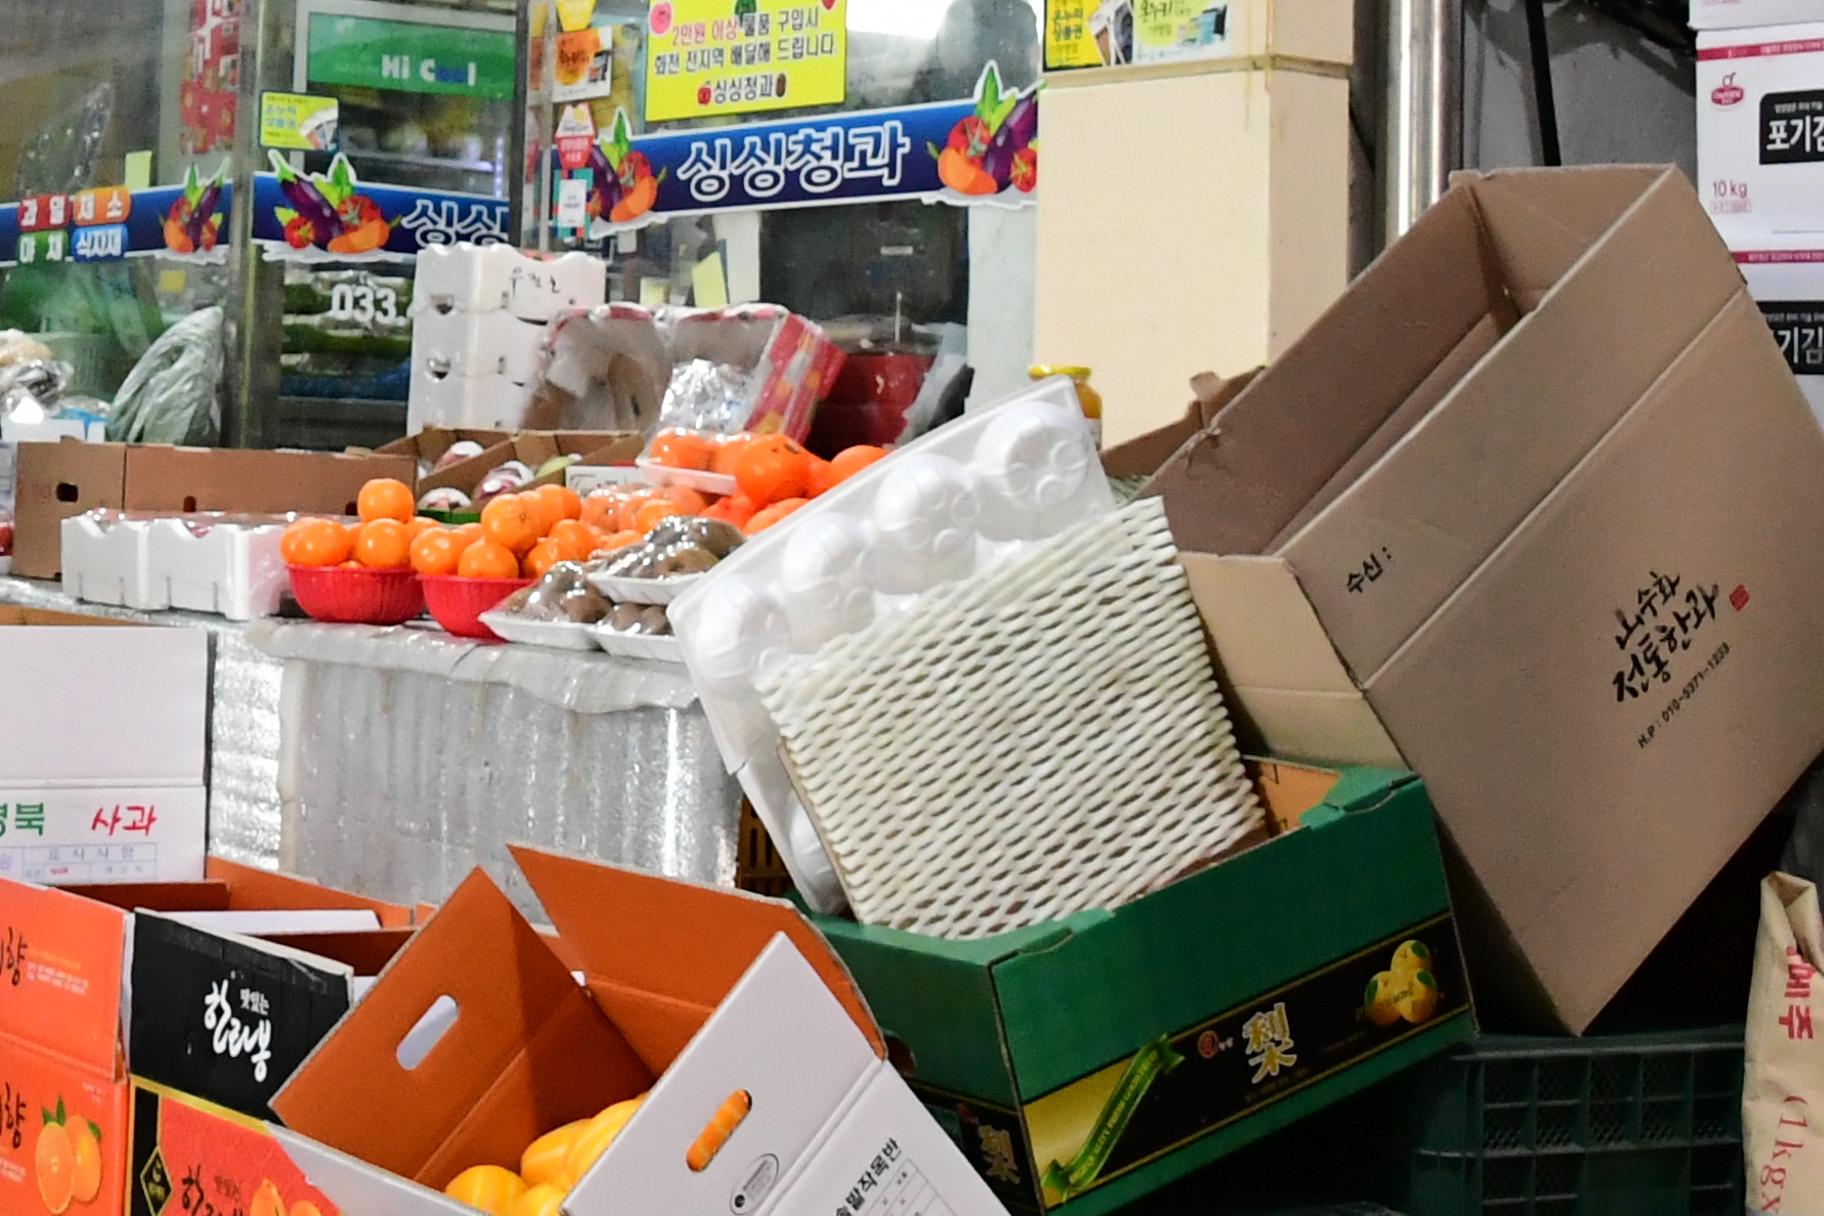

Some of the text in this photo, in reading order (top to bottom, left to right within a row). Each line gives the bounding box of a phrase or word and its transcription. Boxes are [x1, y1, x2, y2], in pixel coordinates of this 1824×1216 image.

[672, 21, 706, 47] 2만원
[711, 18, 739, 42] 이상
[777, 7, 819, 33] 구입시
[655, 53, 680, 76] 화천
[685, 47, 725, 73] 전지역
[730, 41, 771, 66] 배달해
[713, 74, 774, 105] 싱싱청과
[676, 120, 911, 204] 싱싱청과
[1712, 179, 1748, 198] 10 kg
[75, 228, 123, 258] 식자재
[1611, 582, 1720, 704] 전통한과
[90, 803, 158, 837] 사과
[239, 988, 271, 1016] 맛있는
[203, 978, 272, 1083] 한라봉
